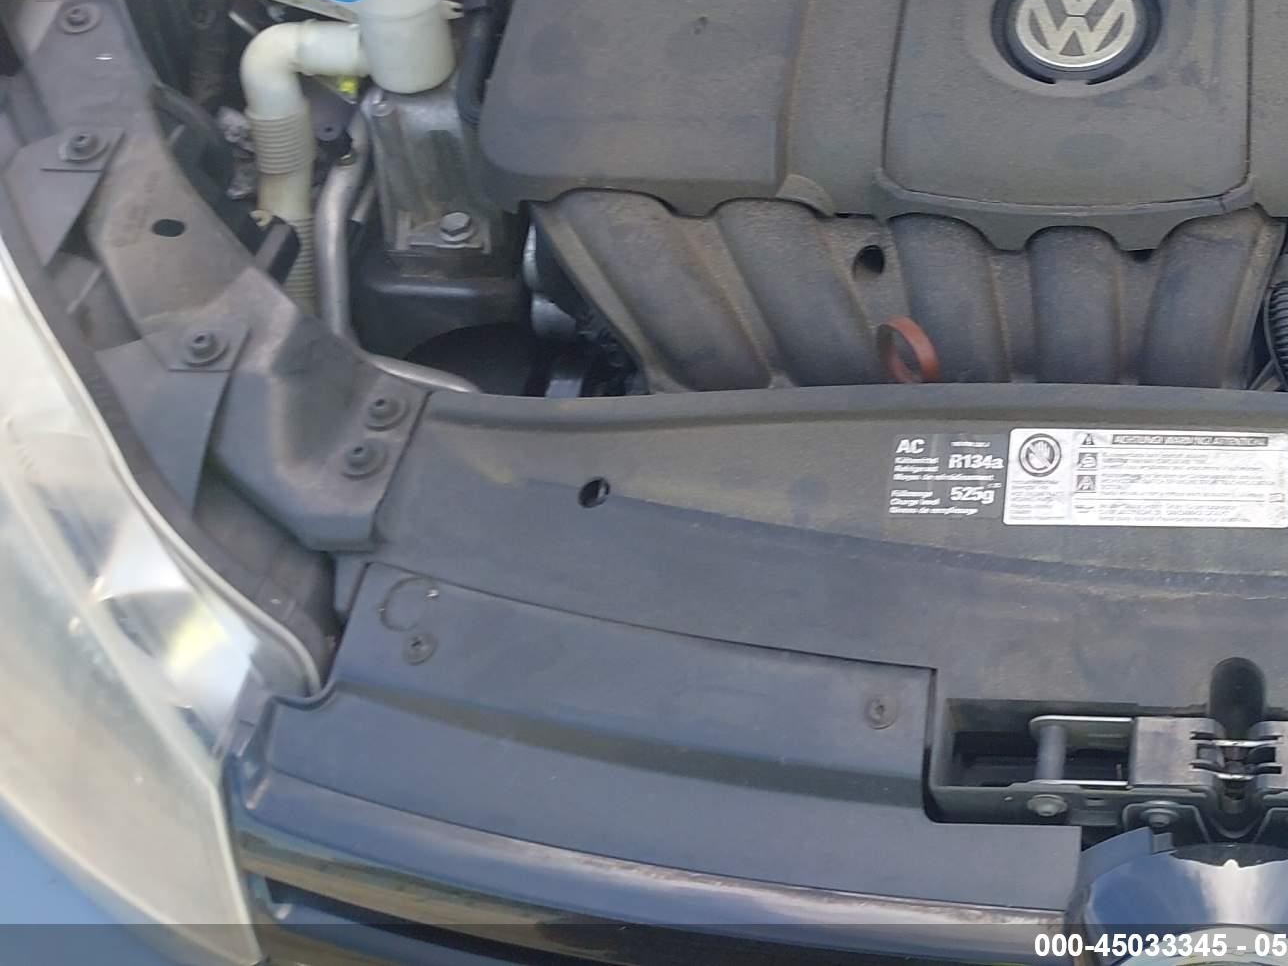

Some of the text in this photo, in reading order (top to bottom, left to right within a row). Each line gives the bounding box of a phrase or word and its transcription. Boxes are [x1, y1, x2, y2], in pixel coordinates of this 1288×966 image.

[896, 439, 925, 454] AC
[948, 454, 1004, 469] R134a
[950, 486, 995, 505] 525g
